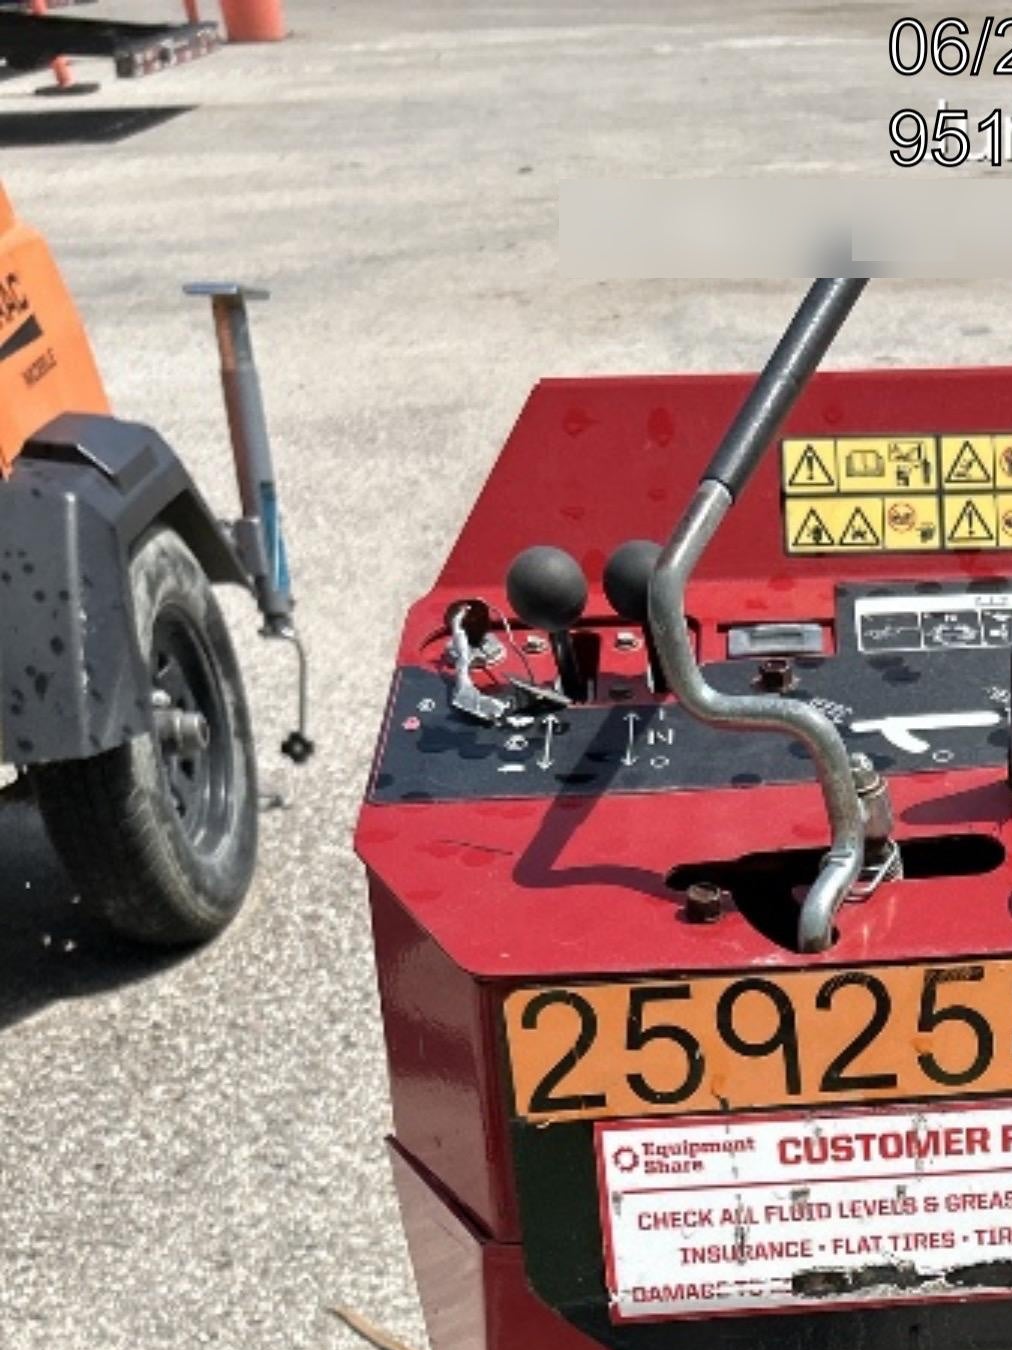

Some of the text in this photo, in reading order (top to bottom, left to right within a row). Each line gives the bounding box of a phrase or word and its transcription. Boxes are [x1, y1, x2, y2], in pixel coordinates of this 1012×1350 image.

[641, 1137, 756, 1159] Equipment
[776, 1126, 992, 1165] CUSTOMER
[643, 1160, 704, 1174] Share
[638, 1206, 713, 1231] CHECK
[719, 1205, 760, 1226] ALL
[764, 1201, 832, 1224] FLUID
[838, 1196, 919, 1220] LEVELS
[924, 1195, 940, 1213] &
[679, 1239, 814, 1265] INSURANCE
[831, 1235, 883, 1256] FLAT
[888, 1231, 956, 1252] TIRES
